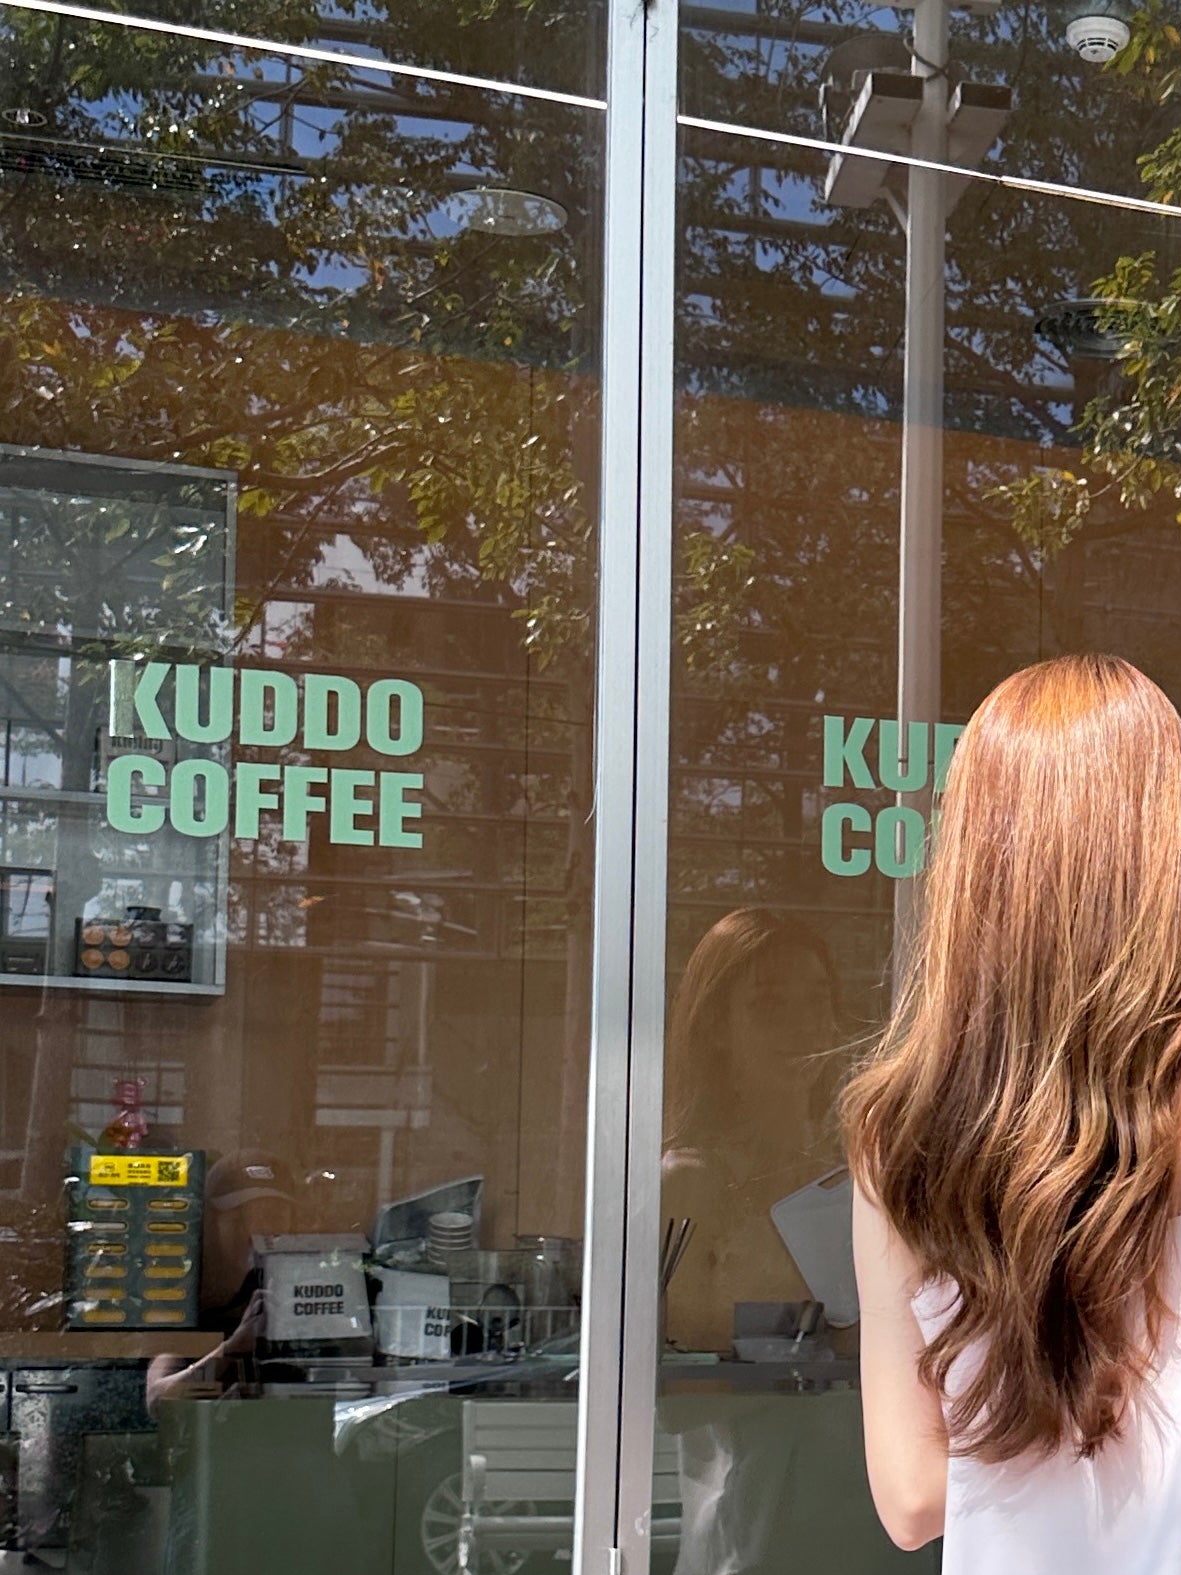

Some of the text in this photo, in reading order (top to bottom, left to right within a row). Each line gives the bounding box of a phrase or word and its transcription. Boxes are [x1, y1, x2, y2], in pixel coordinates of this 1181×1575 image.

[108, 659, 424, 755] KUDDO
[106, 754, 424, 848] COFFEE
[821, 802, 938, 879] CO
[294, 1284, 344, 1298] KUDDO
[294, 1301, 344, 1316] COFFEE
